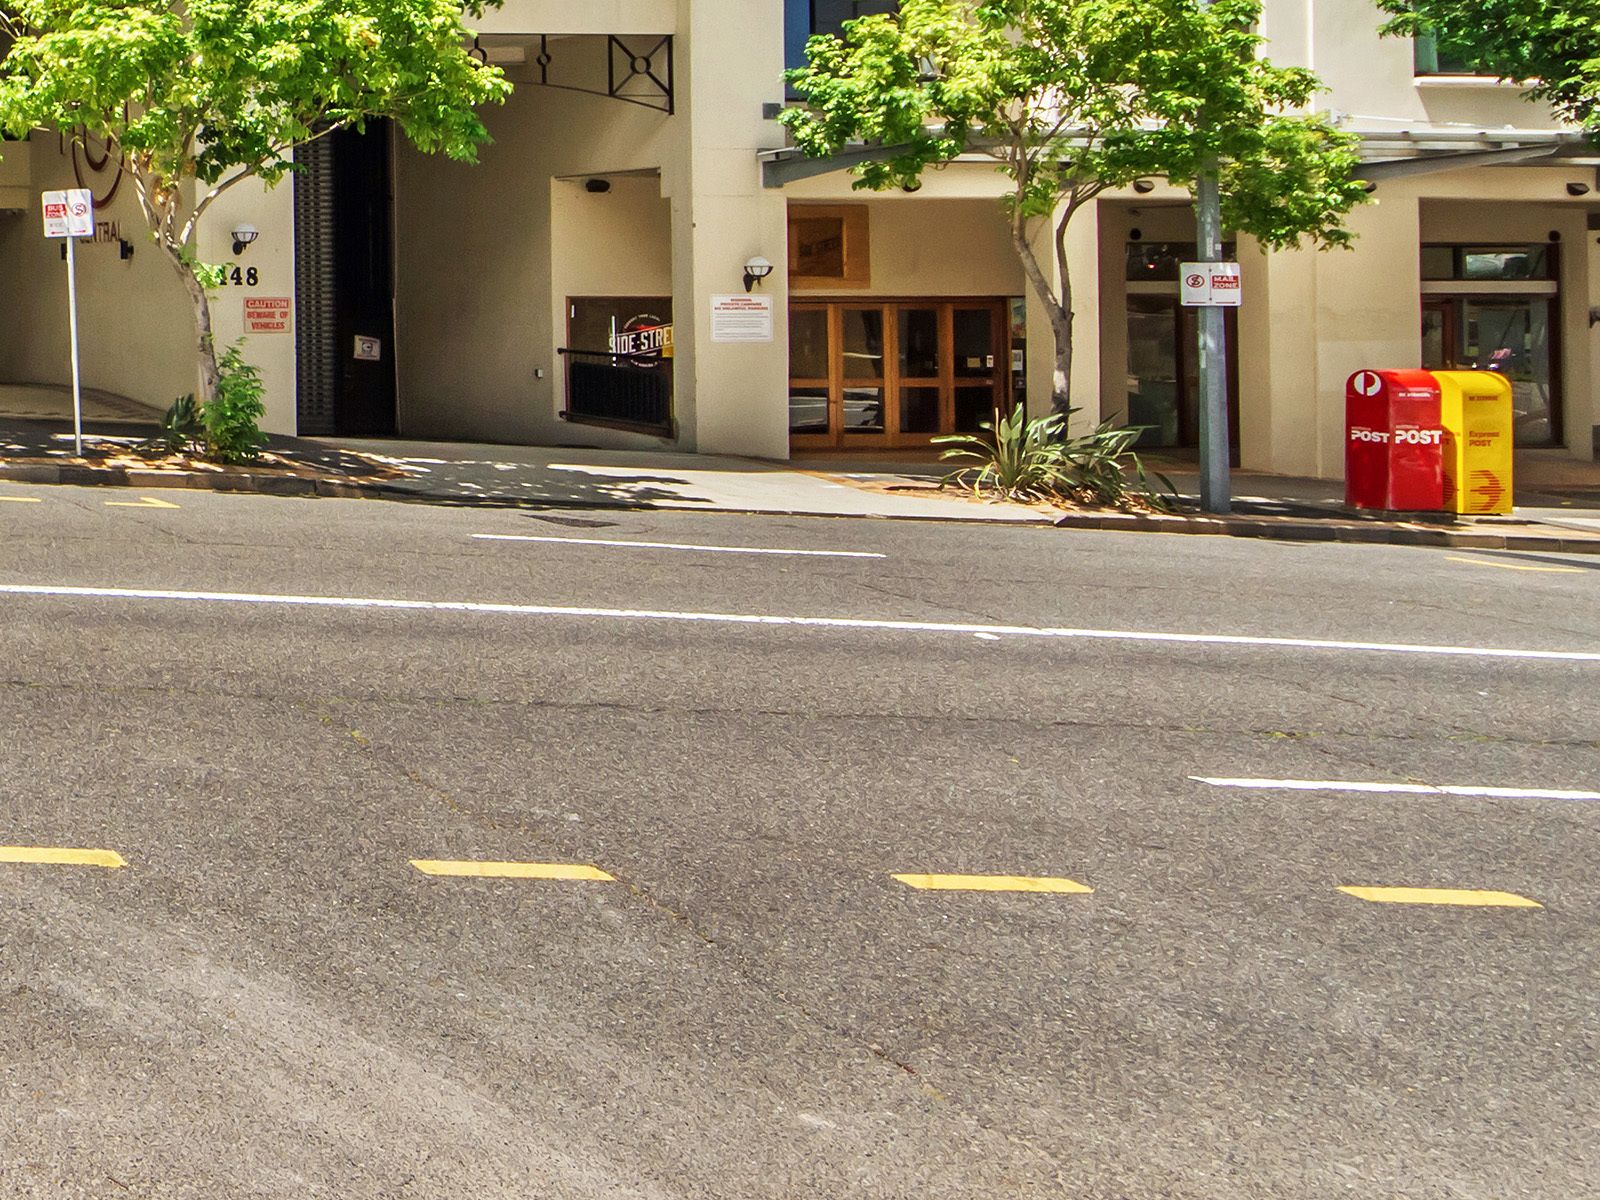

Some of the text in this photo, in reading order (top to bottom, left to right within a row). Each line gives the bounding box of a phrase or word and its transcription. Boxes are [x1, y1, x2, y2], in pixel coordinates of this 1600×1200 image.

[247, 300, 288, 308] CAUTION
[252, 322, 285, 330] VEHICLES
[1351, 430, 1390, 443] POST
[1394, 429, 1443, 445] POST
